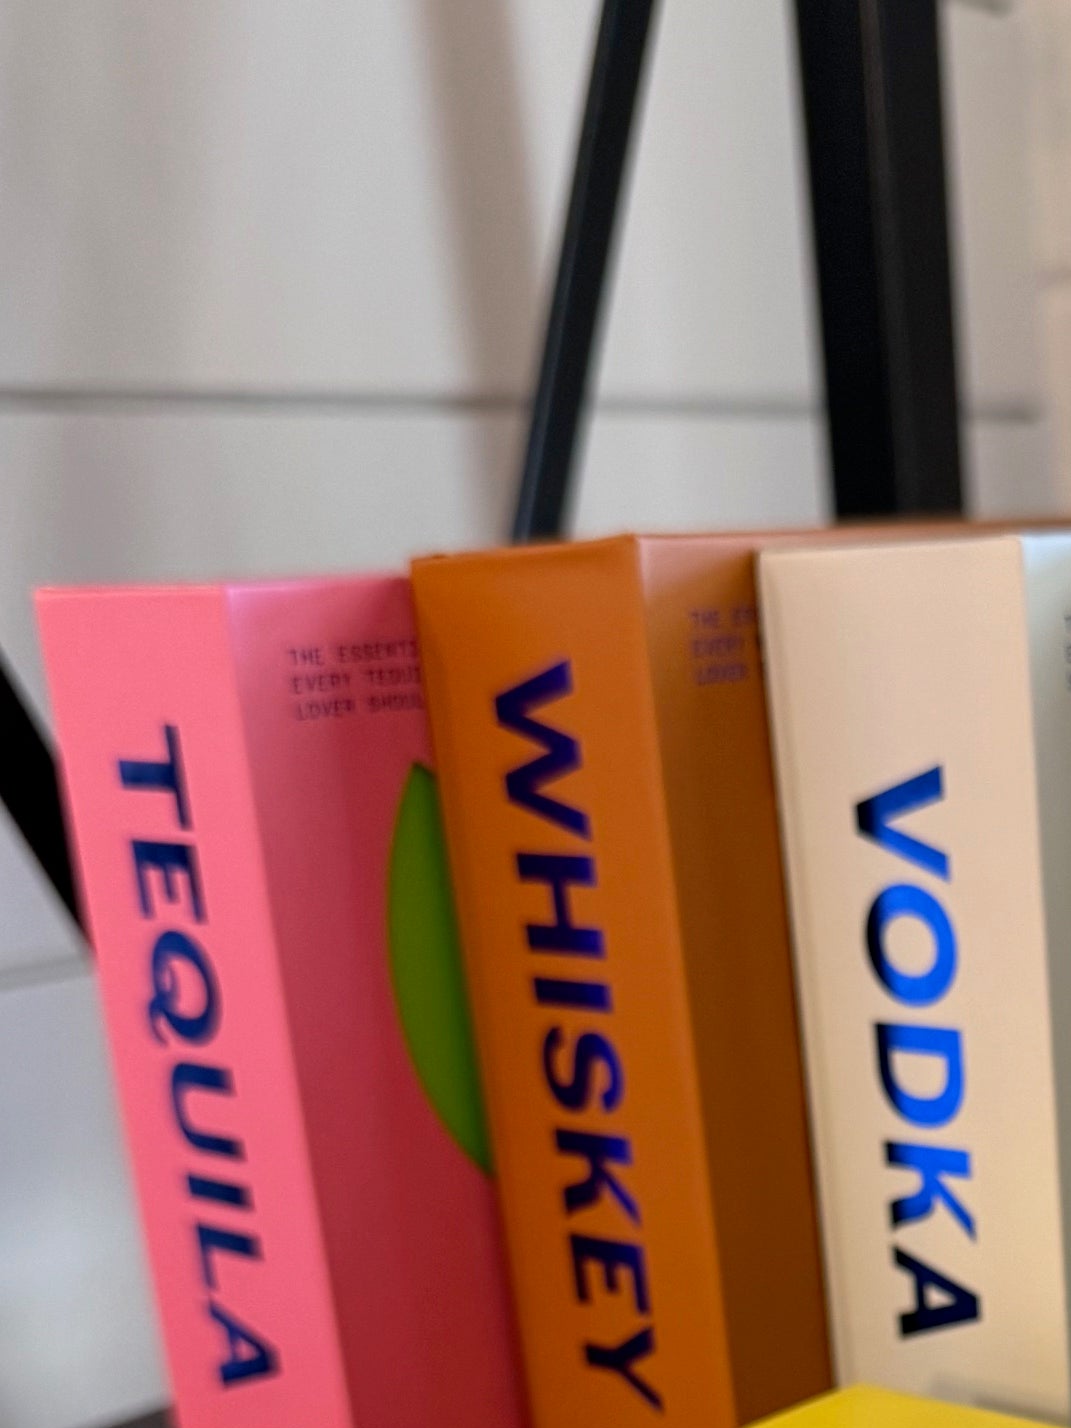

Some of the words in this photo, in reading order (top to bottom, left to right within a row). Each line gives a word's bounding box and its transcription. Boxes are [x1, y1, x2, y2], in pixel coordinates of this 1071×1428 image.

[290, 648, 323, 665] THE
[292, 672, 351, 694] EVERY
[297, 699, 355, 721] LOVER
[116, 724, 281, 1390] TEQUILA
[494, 659, 665, 1414] WHISKEY
[855, 763, 983, 1339] VODKA
